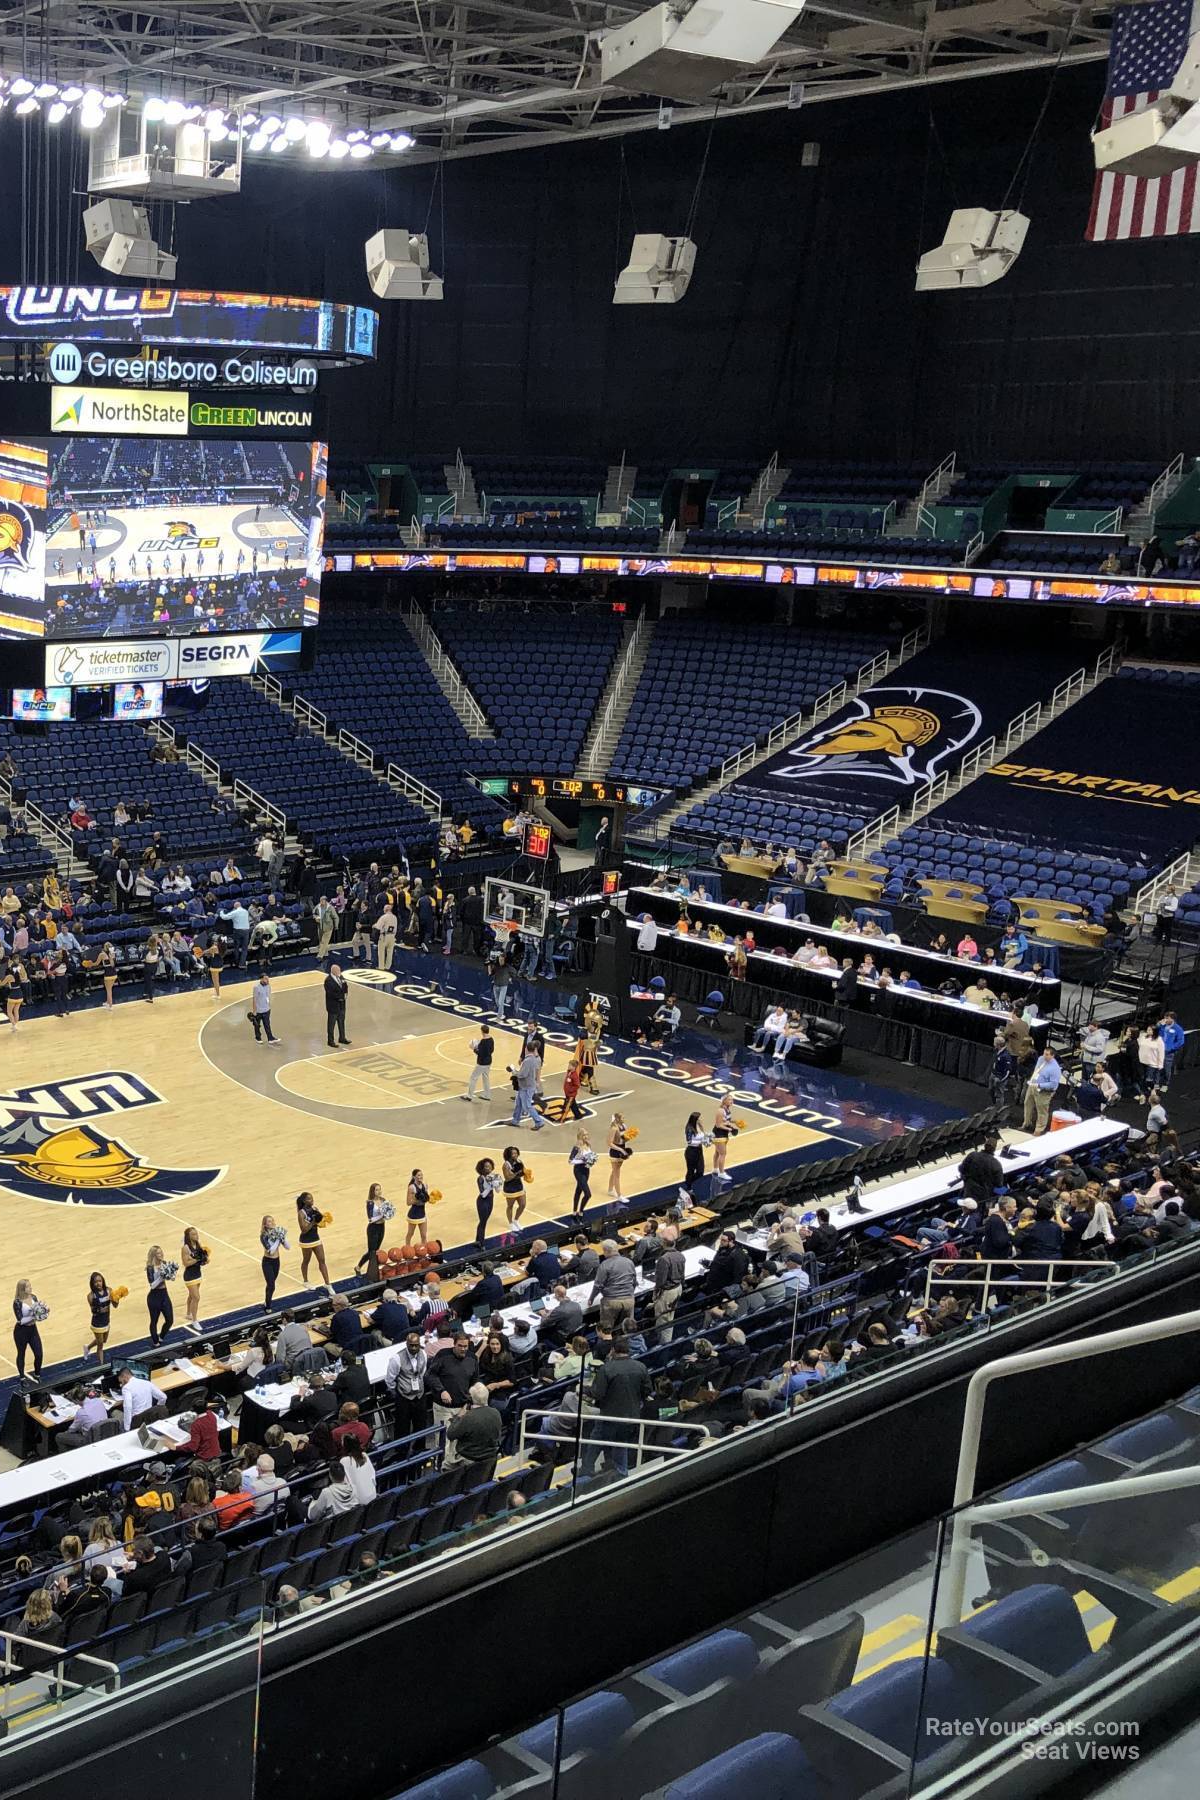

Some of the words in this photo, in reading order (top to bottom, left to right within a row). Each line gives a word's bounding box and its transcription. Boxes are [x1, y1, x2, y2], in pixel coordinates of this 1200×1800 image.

[88, 351, 217, 382] Greensboro
[224, 358, 318, 385] Coliseum
[92, 401, 185, 424] NorthState
[190, 403, 256, 427] GREEN
[257, 410, 312, 426] LINCOLN
[137, 536, 221, 552] UNCG
[89, 649, 163, 665] ticketmaster
[181, 644, 250, 663] SEGRA
[88, 664, 125, 676] VERIFIED
[126, 663, 159, 675] TICKETS
[538, 785, 545, 795] 0
[597, 789, 605, 799] 0
[528, 836, 545, 854] 30
[625, 1056, 842, 1129] Coliseum
